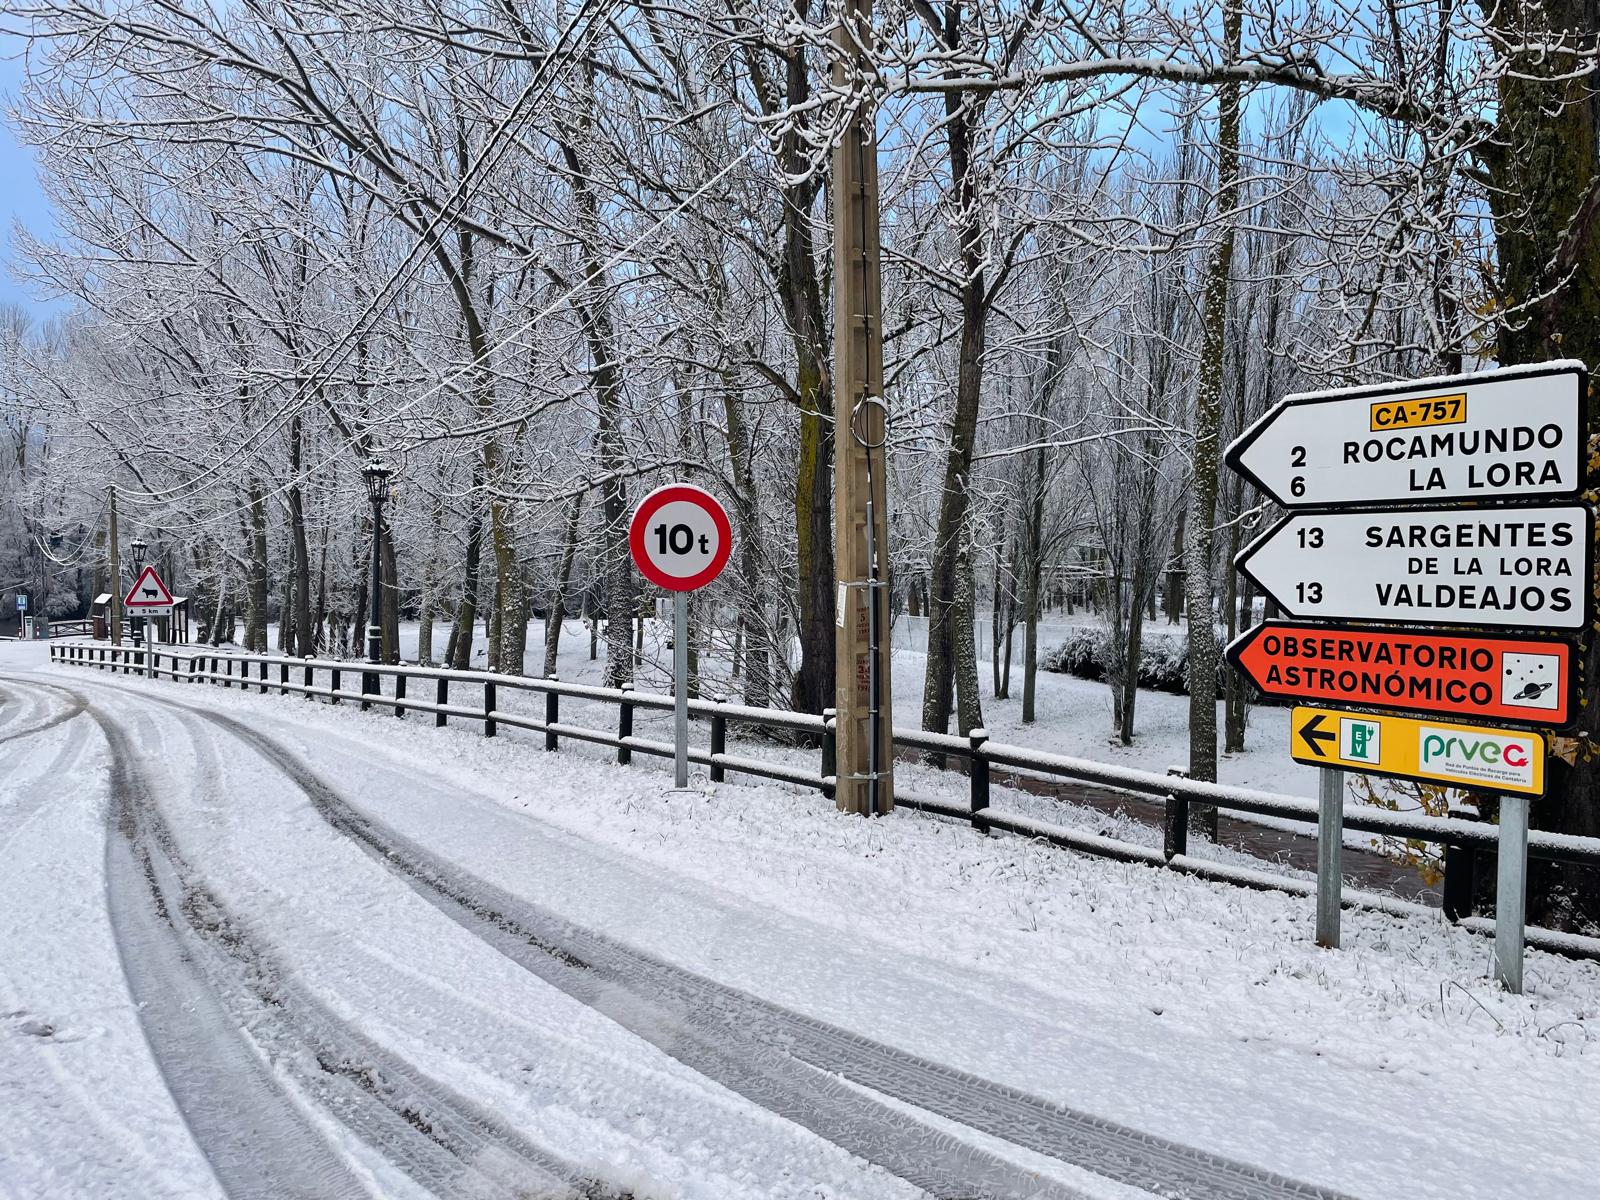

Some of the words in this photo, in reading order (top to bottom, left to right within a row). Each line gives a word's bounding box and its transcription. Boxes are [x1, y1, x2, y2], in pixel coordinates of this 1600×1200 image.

[1375, 400, 1461, 426] CA-757
[1290, 446, 1307, 468] 2
[1343, 423, 1563, 464] ROCAMUNDO
[1290, 476, 1306, 497] 6
[1409, 467, 1446, 491] LA
[1468, 460, 1562, 488] LORA
[654, 524, 694, 555] 10
[698, 534, 709, 555] t
[1297, 527, 1324, 549] 13
[1365, 522, 1573, 548] SARGENTES
[1408, 558, 1438, 575] DE
[1454, 558, 1483, 575] LA
[1500, 557, 1572, 576] LORA
[1295, 582, 1323, 604] 13
[1375, 583, 1572, 612] VALDEAJOS
[1263, 635, 1494, 672] OBSERVATORIO
[1265, 664, 1493, 705] ASTRONÓMICO
[1423, 734, 1529, 768] prvec
